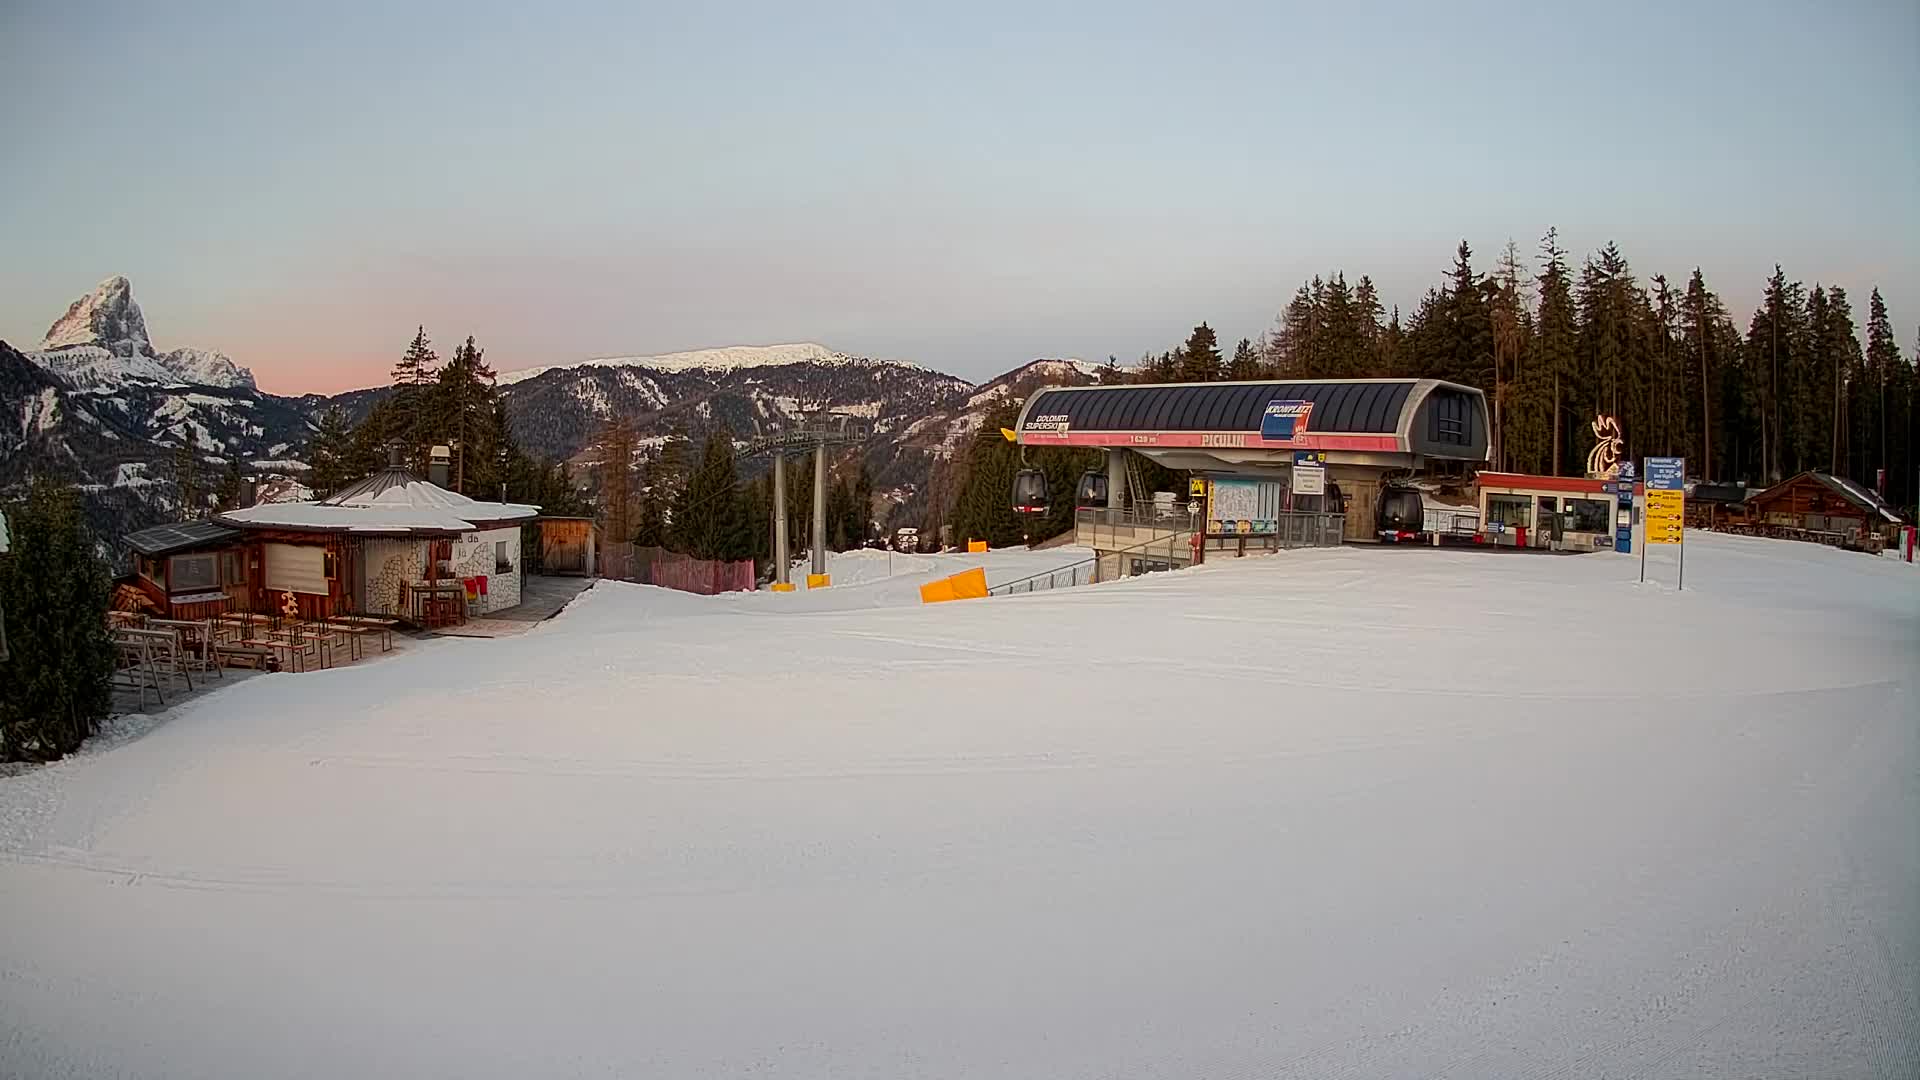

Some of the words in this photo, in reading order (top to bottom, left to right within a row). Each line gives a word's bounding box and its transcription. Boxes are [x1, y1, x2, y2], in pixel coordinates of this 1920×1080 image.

[1025, 422, 1058, 430] SUPERSKI
[1201, 434, 1245, 447] PICULIN
[467, 534, 479, 543] da
